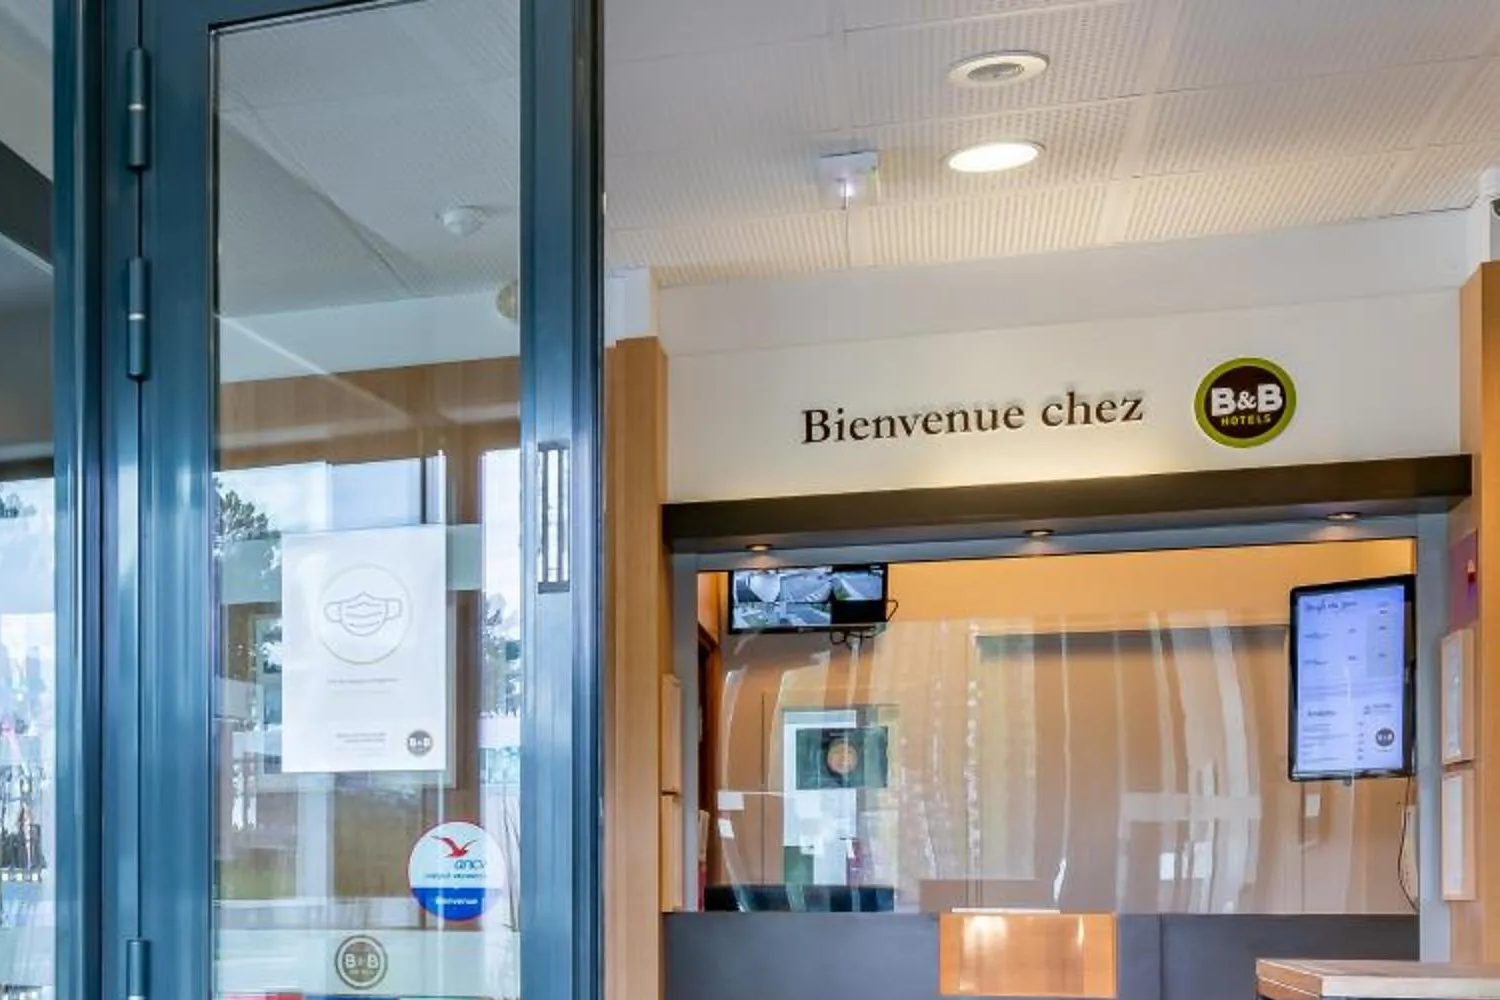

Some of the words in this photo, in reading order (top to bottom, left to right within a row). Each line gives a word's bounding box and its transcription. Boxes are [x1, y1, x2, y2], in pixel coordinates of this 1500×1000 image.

[801, 403, 1025, 444] Bienvenue
[1041, 390, 1144, 427] chez
[1211, 383, 1283, 417] B&B
[1221, 413, 1271, 427] HOTELS
